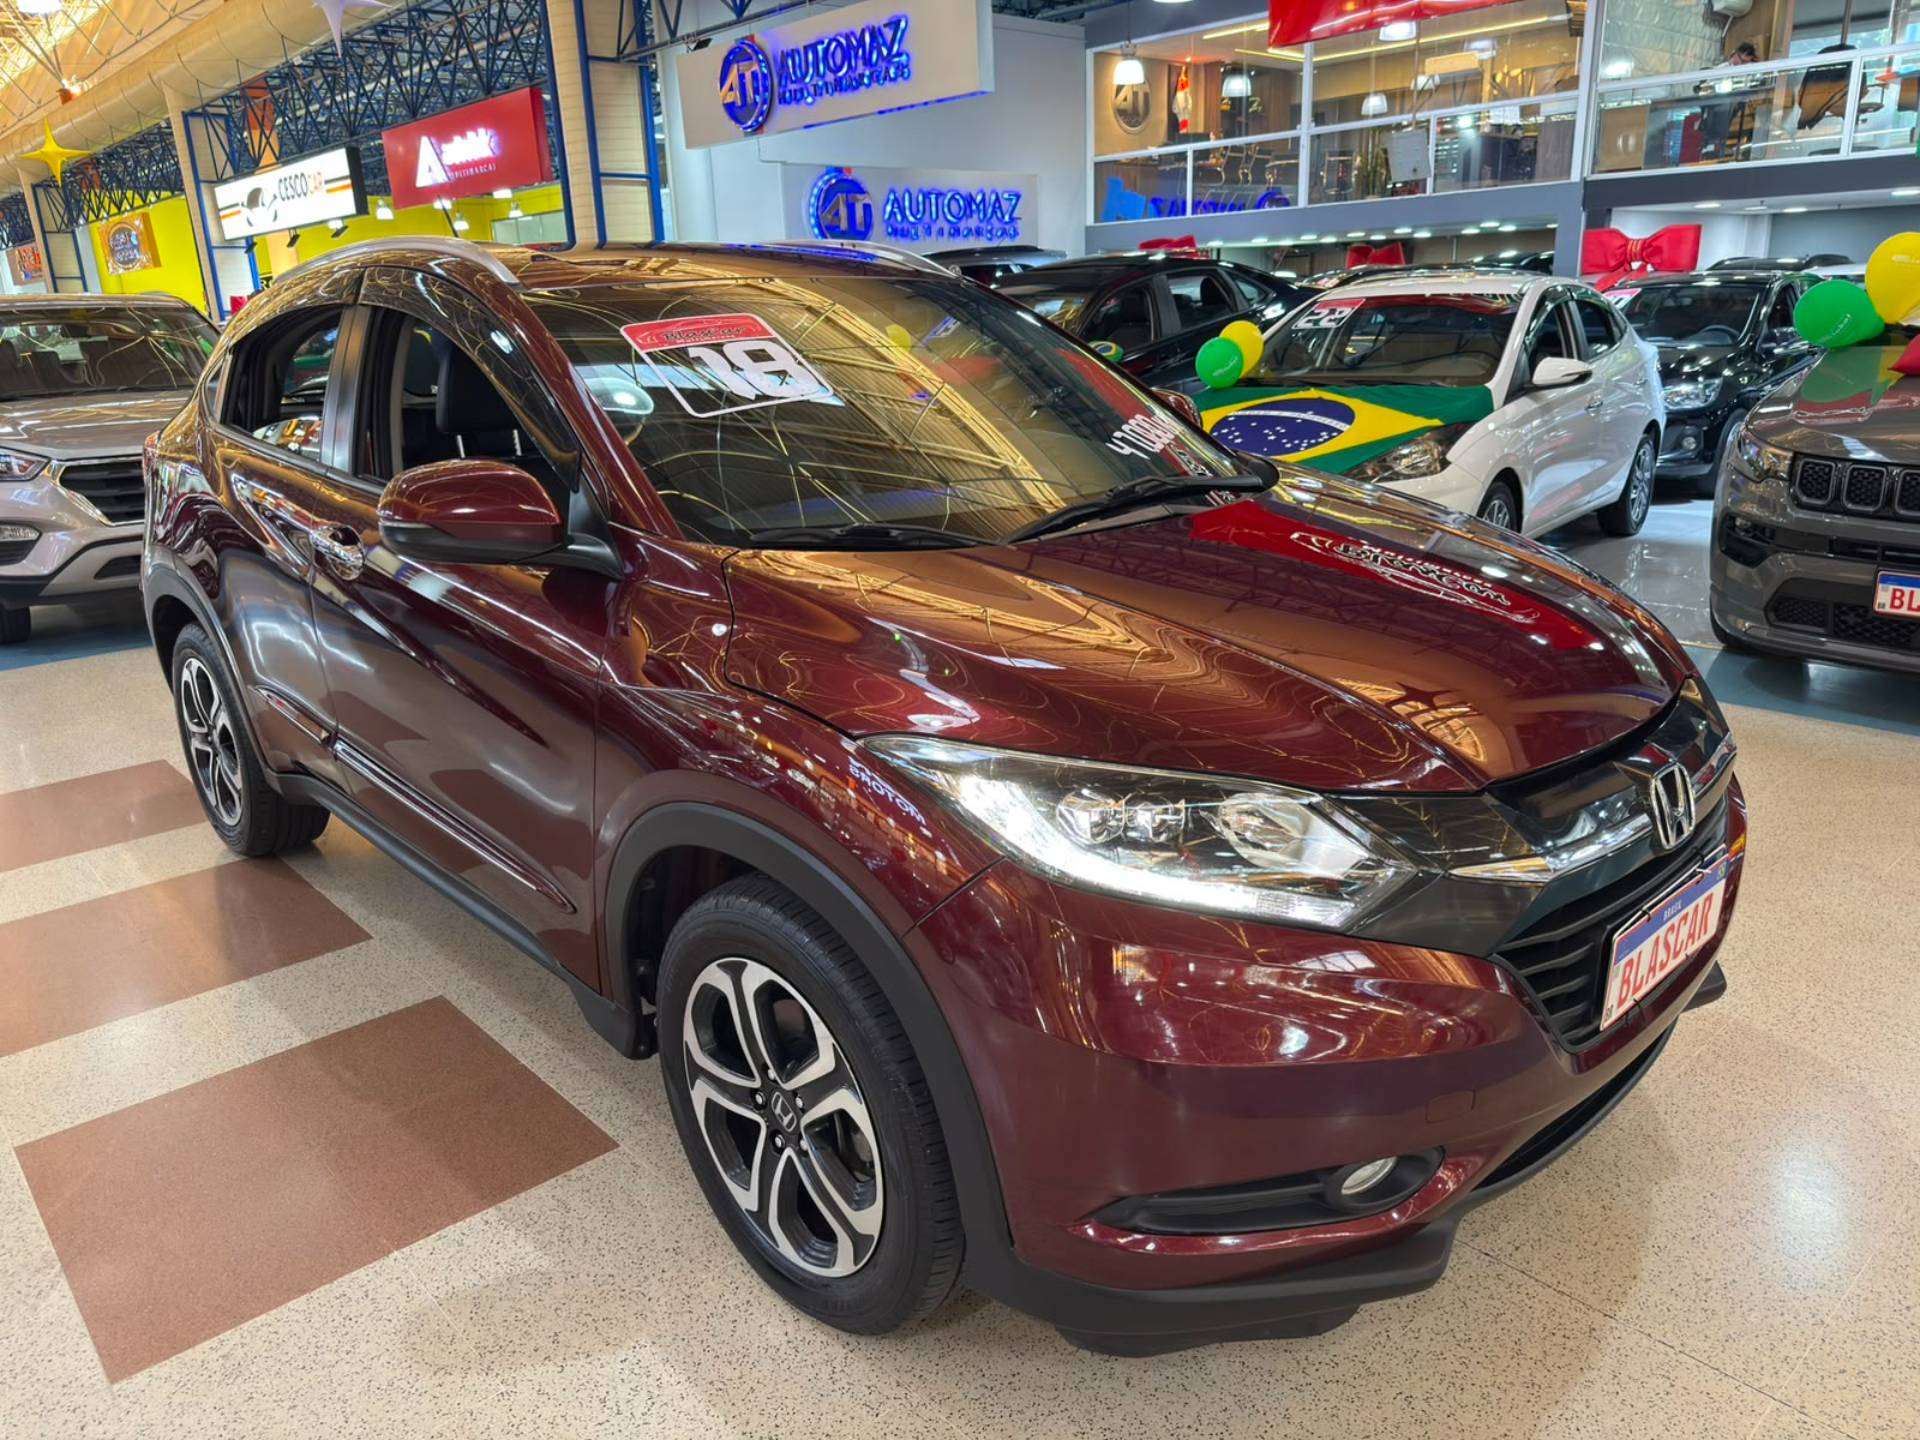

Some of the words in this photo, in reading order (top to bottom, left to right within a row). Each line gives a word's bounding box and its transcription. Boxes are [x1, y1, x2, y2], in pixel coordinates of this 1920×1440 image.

[779, 17, 908, 86] AUTOMAZ
[884, 189, 1021, 222] AUTOMAZ
[687, 340, 822, 400] 18
[1617, 893, 1713, 1009] BLASCAR
